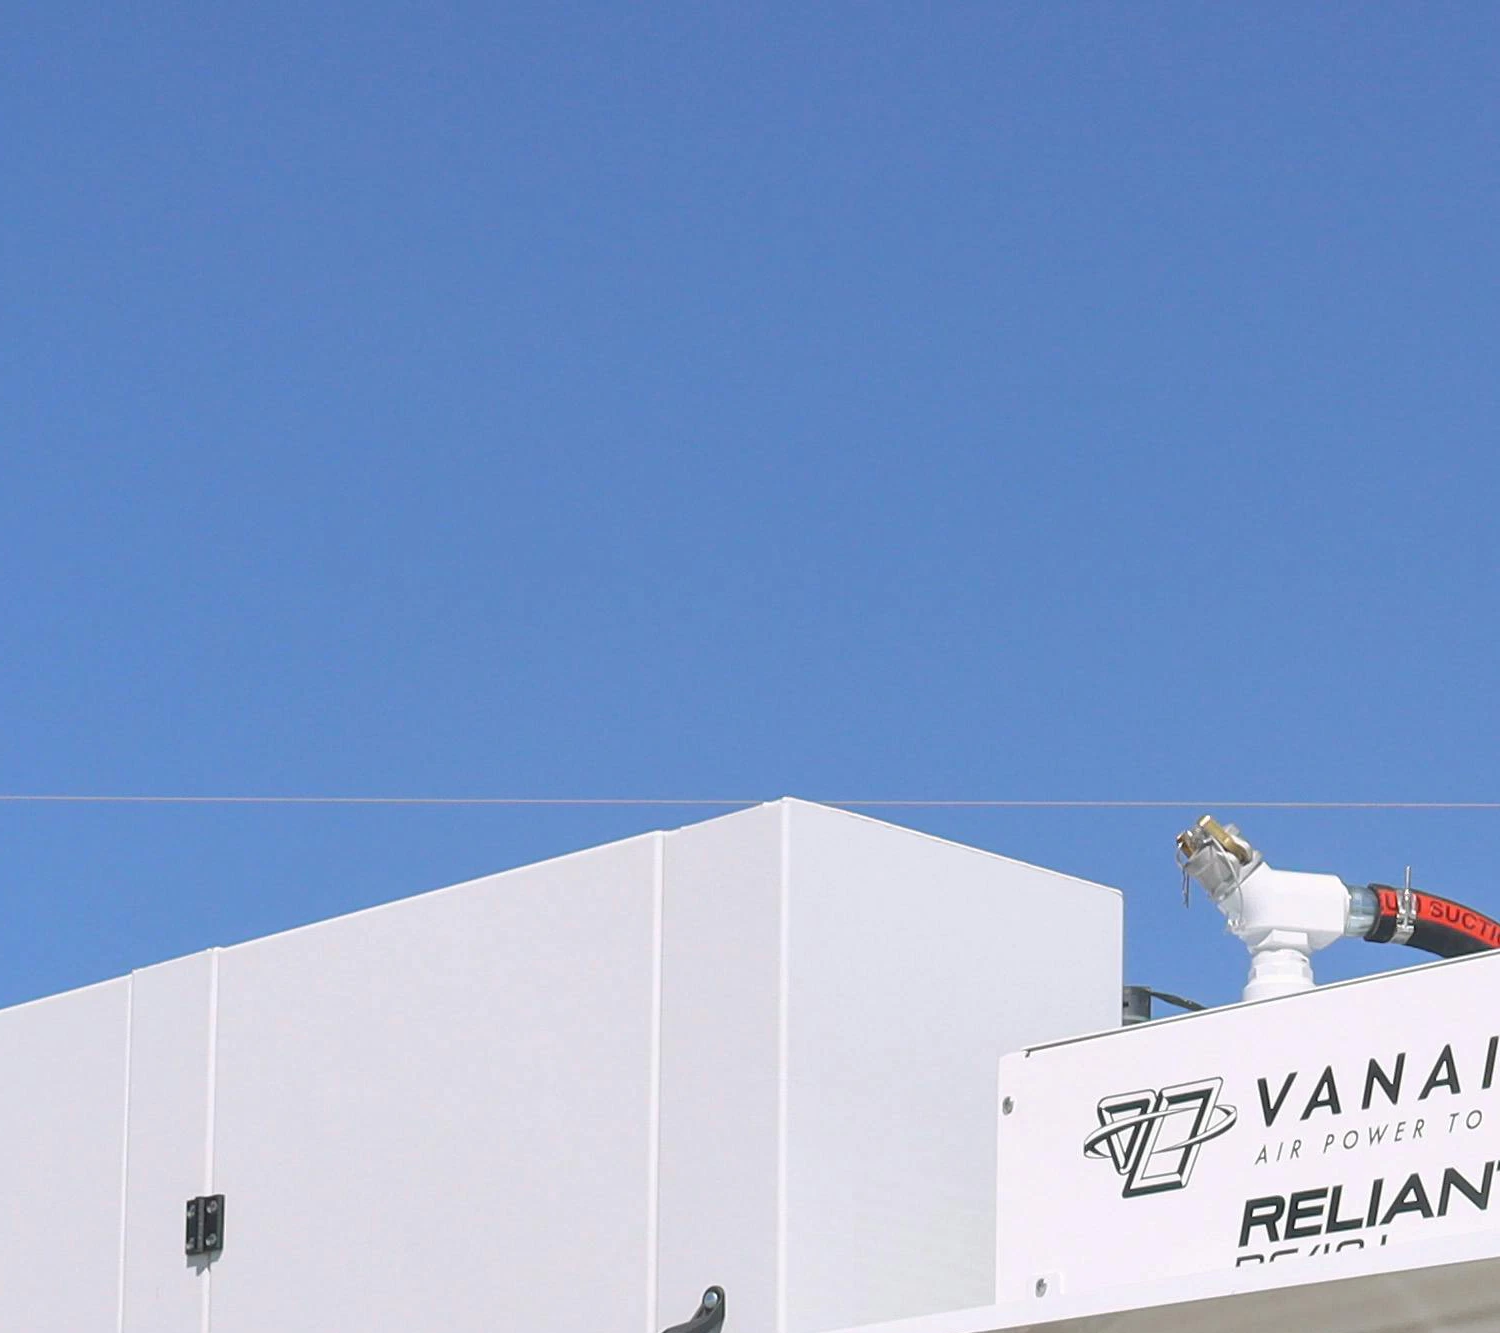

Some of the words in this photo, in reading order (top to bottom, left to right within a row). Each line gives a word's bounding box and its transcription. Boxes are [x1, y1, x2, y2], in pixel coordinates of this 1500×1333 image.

[1255, 1139, 1302, 1166] AIR
[1323, 1118, 1426, 1154] POWER
[1449, 1109, 1483, 1133] TO
